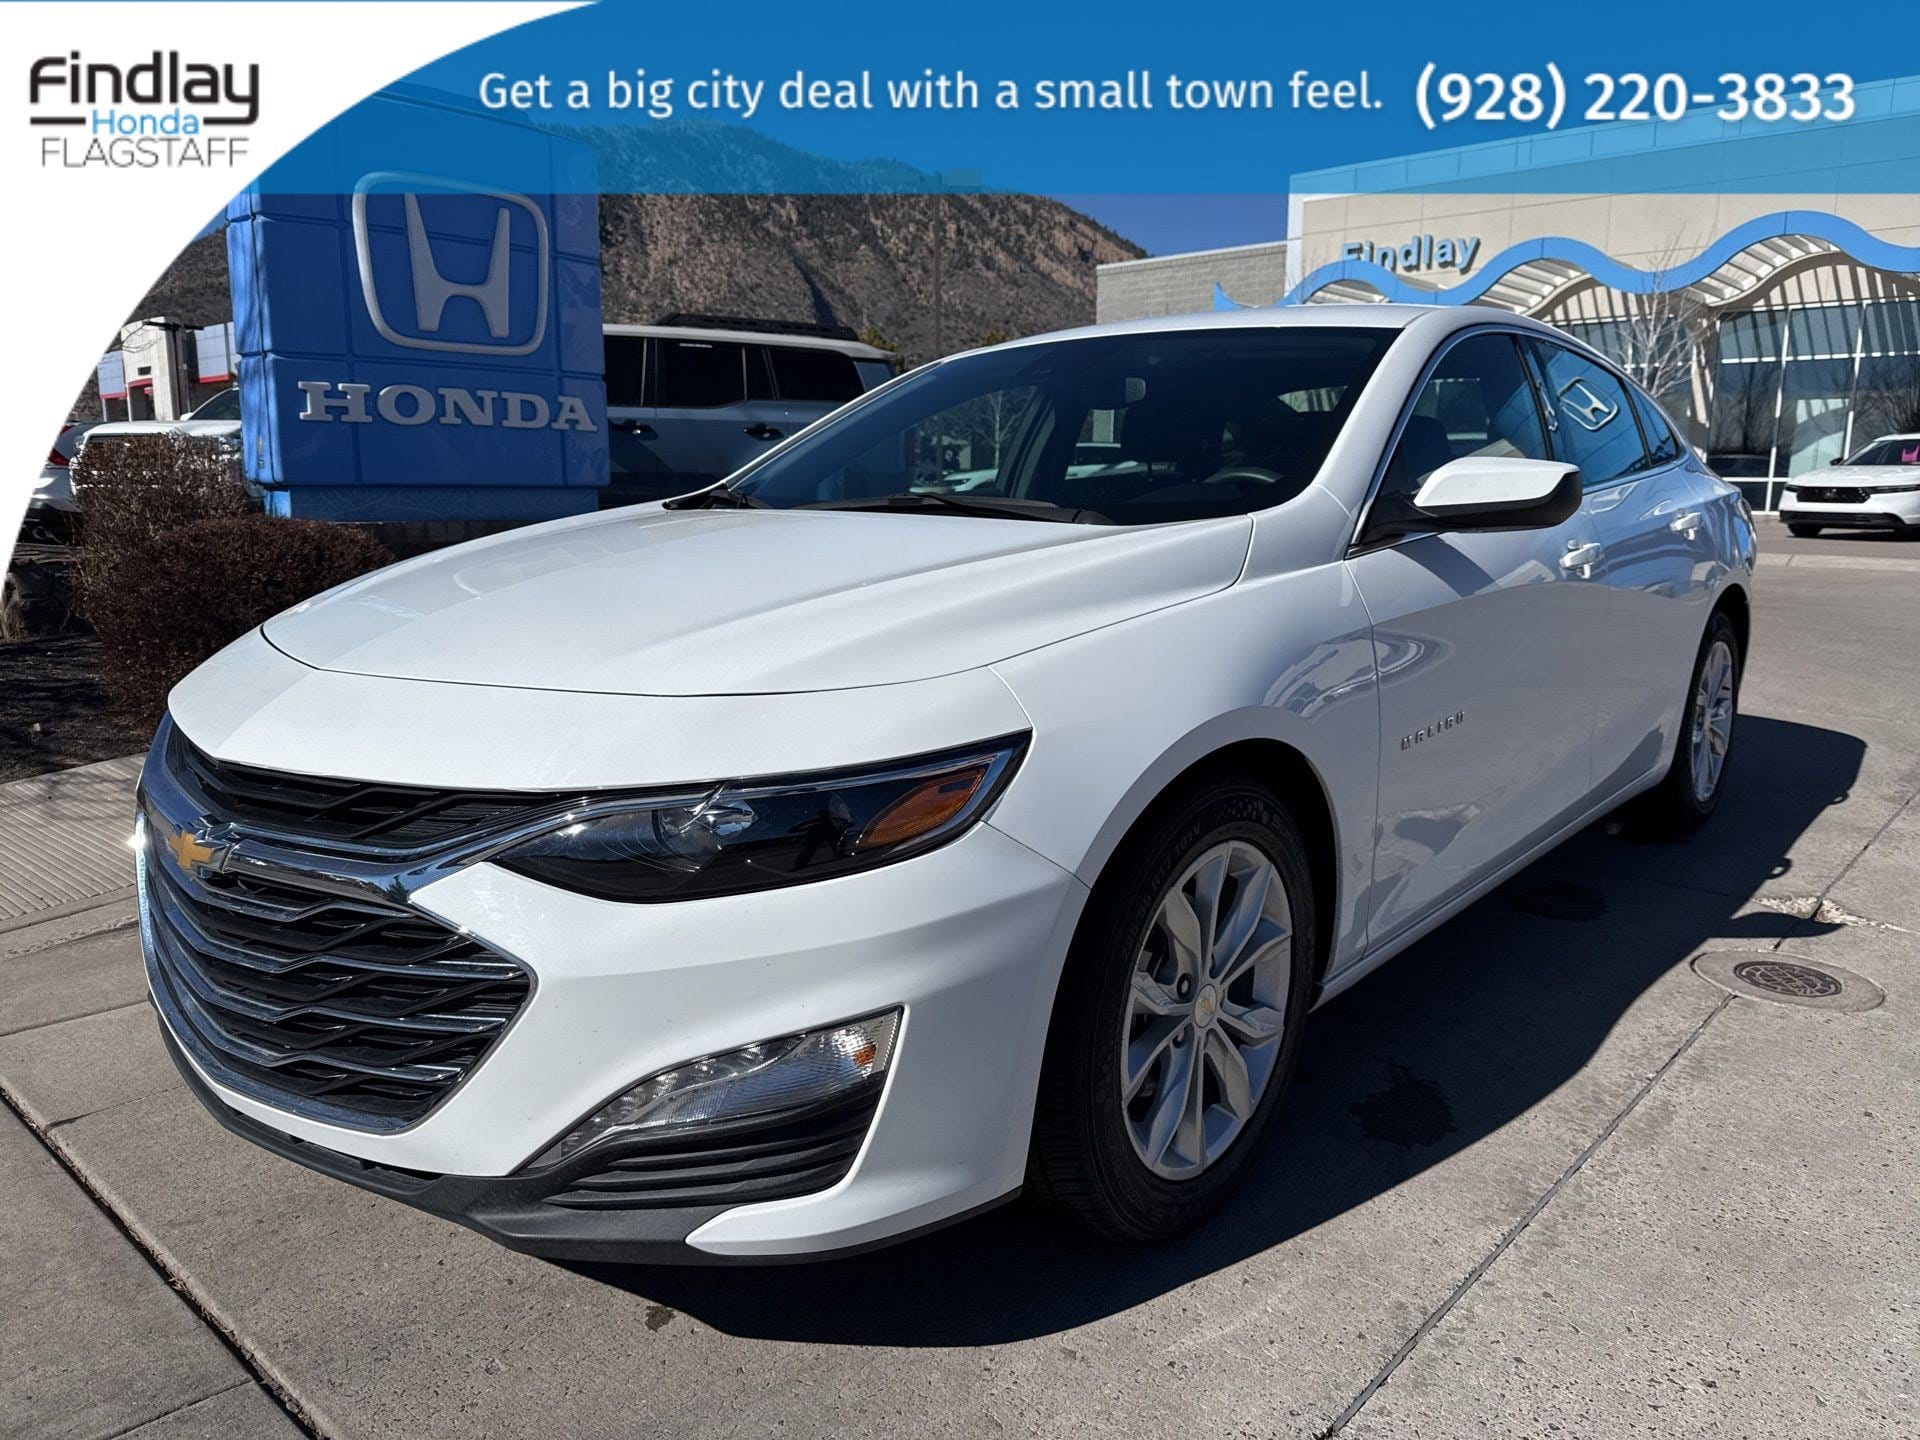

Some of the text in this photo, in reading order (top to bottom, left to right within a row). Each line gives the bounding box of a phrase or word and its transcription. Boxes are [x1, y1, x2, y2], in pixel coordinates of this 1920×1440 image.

[1341, 234, 1481, 275] Findlay
[297, 380, 599, 433] HONDA
[1400, 710, 1466, 752] MALIBU
